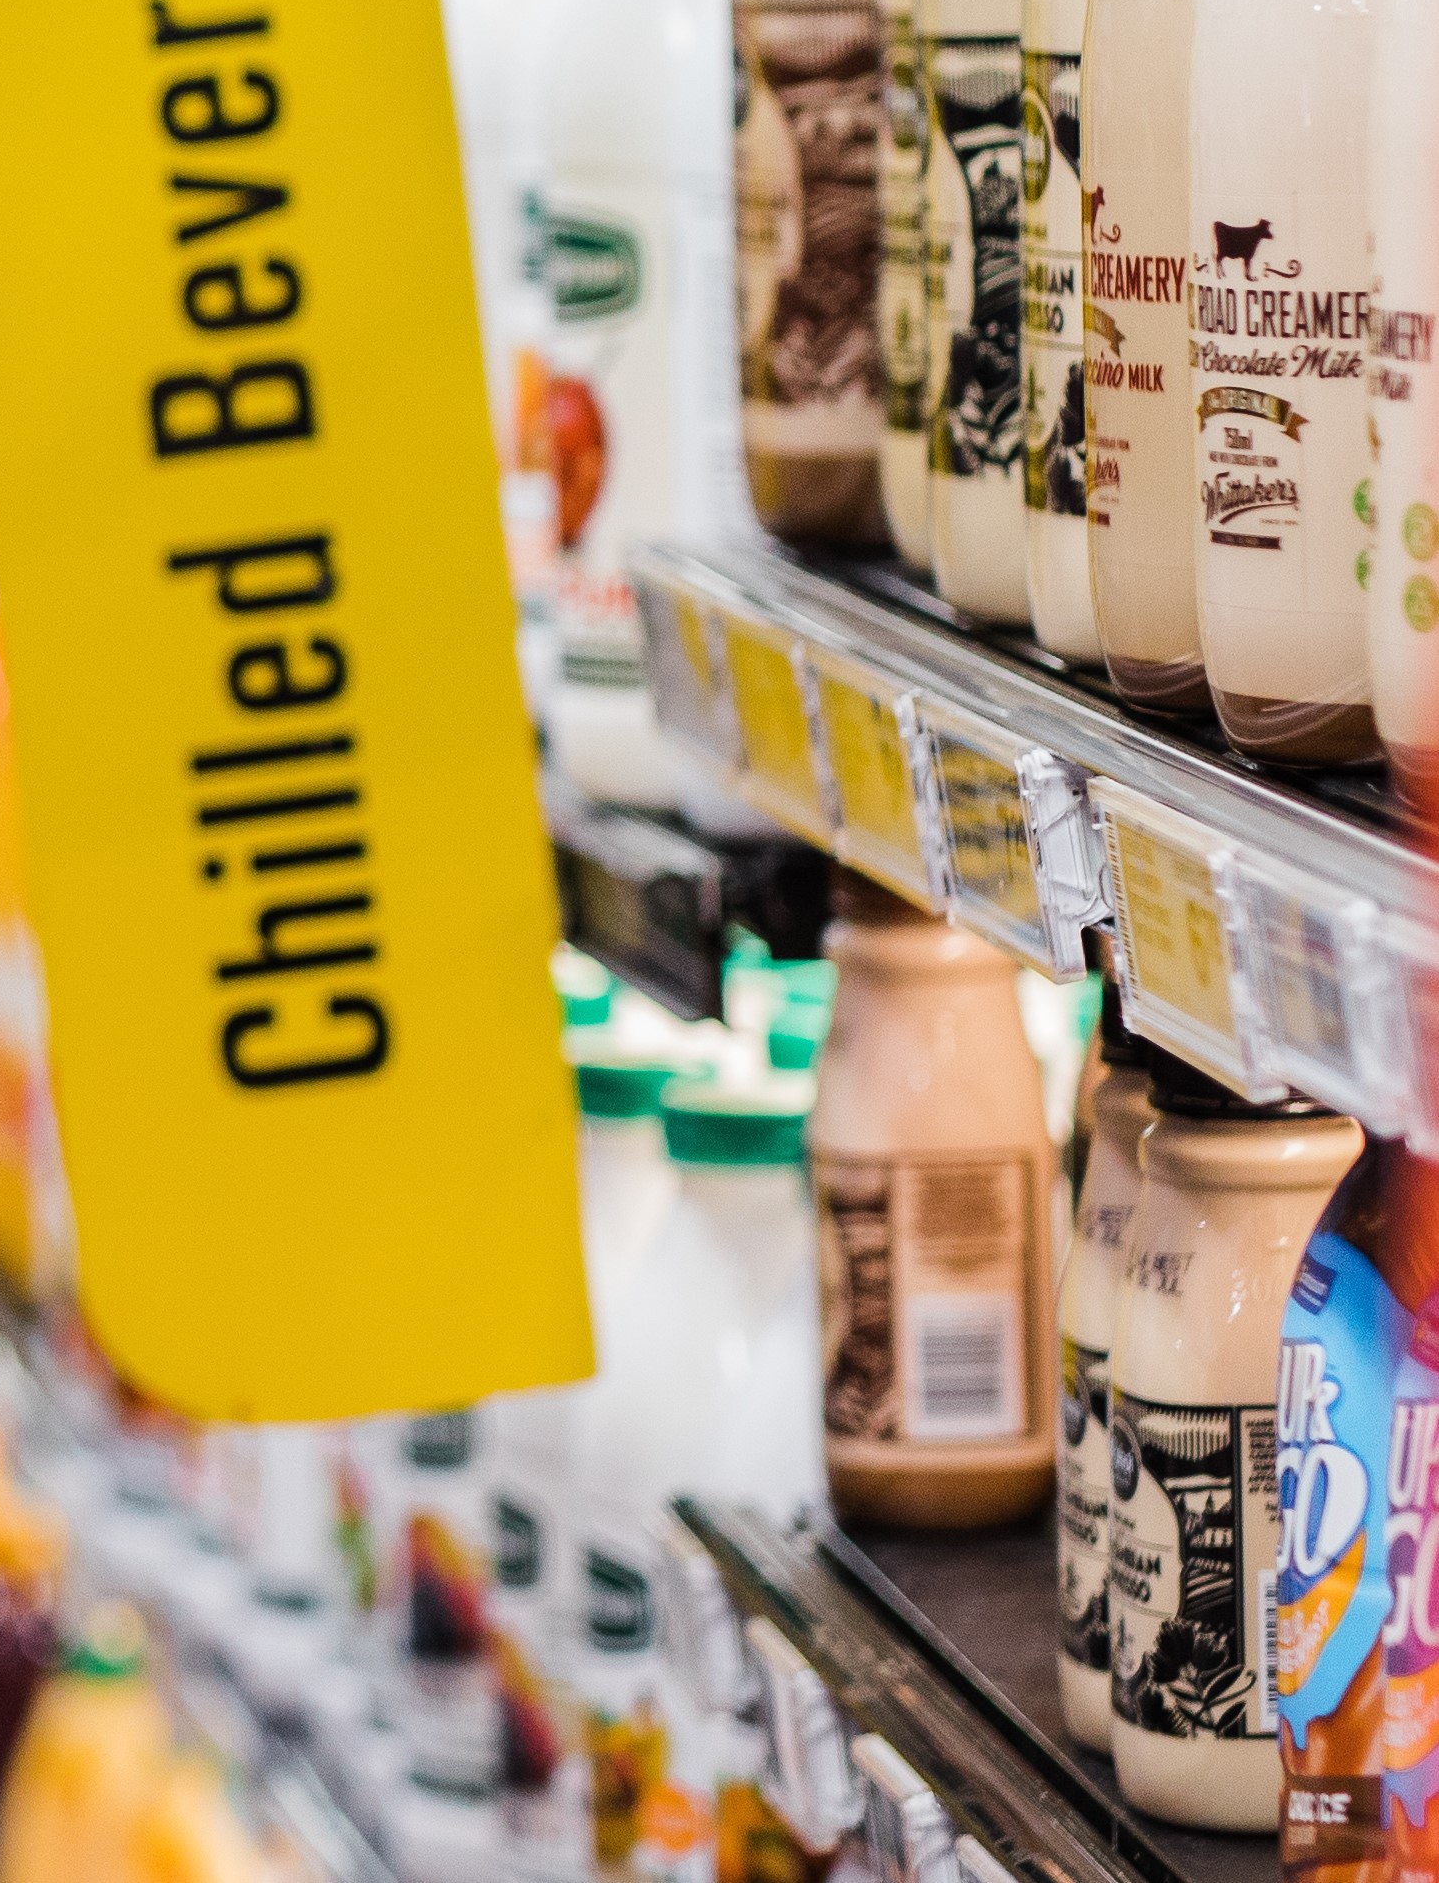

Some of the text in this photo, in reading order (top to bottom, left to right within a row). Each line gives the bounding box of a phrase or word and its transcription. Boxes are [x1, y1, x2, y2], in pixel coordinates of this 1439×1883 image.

[1090, 249, 1187, 305] CREAMERY
[1198, 284, 1372, 340] ROAD CREAMER
[1128, 362, 1165, 393] MILK
[1290, 344, 1364, 380] Milk
[167, 529, 395, 1092] Chilled
